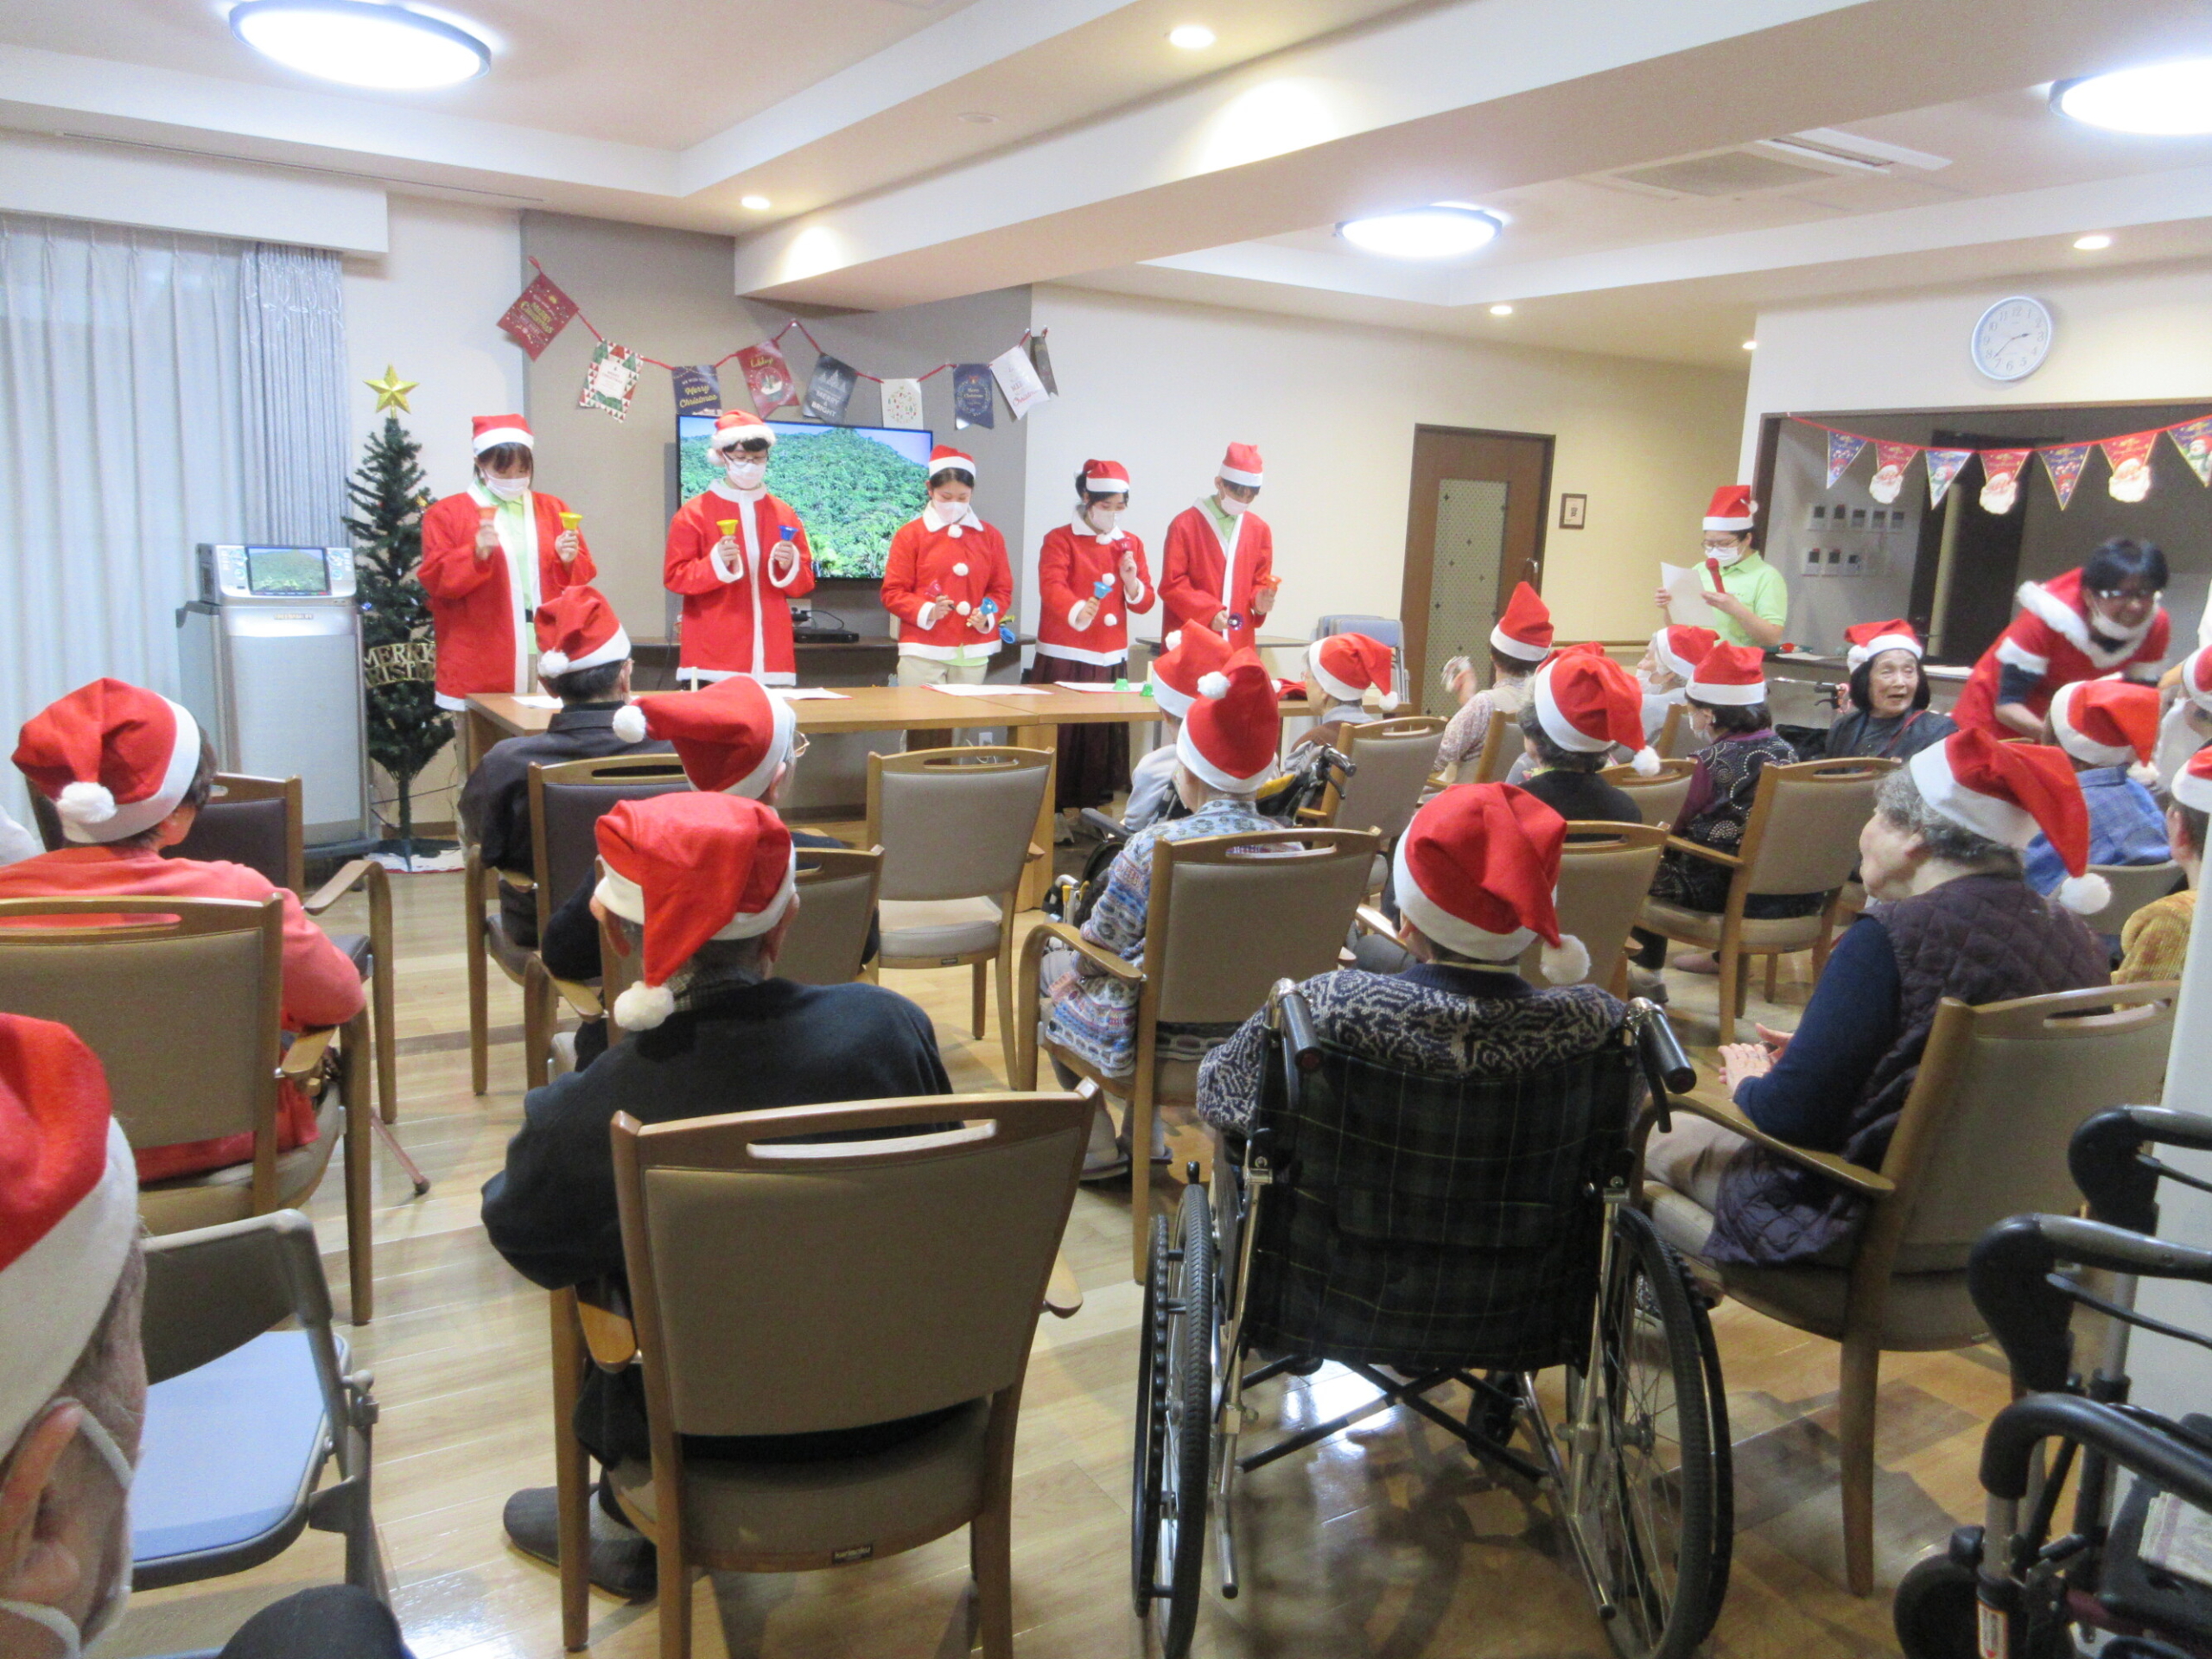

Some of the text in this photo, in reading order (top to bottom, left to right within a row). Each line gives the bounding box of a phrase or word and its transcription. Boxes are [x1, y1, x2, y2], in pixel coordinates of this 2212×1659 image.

[685, 385, 709, 395] Merry
[679, 394, 717, 408] Christmas
[810, 400, 837, 417] BRIGHT
